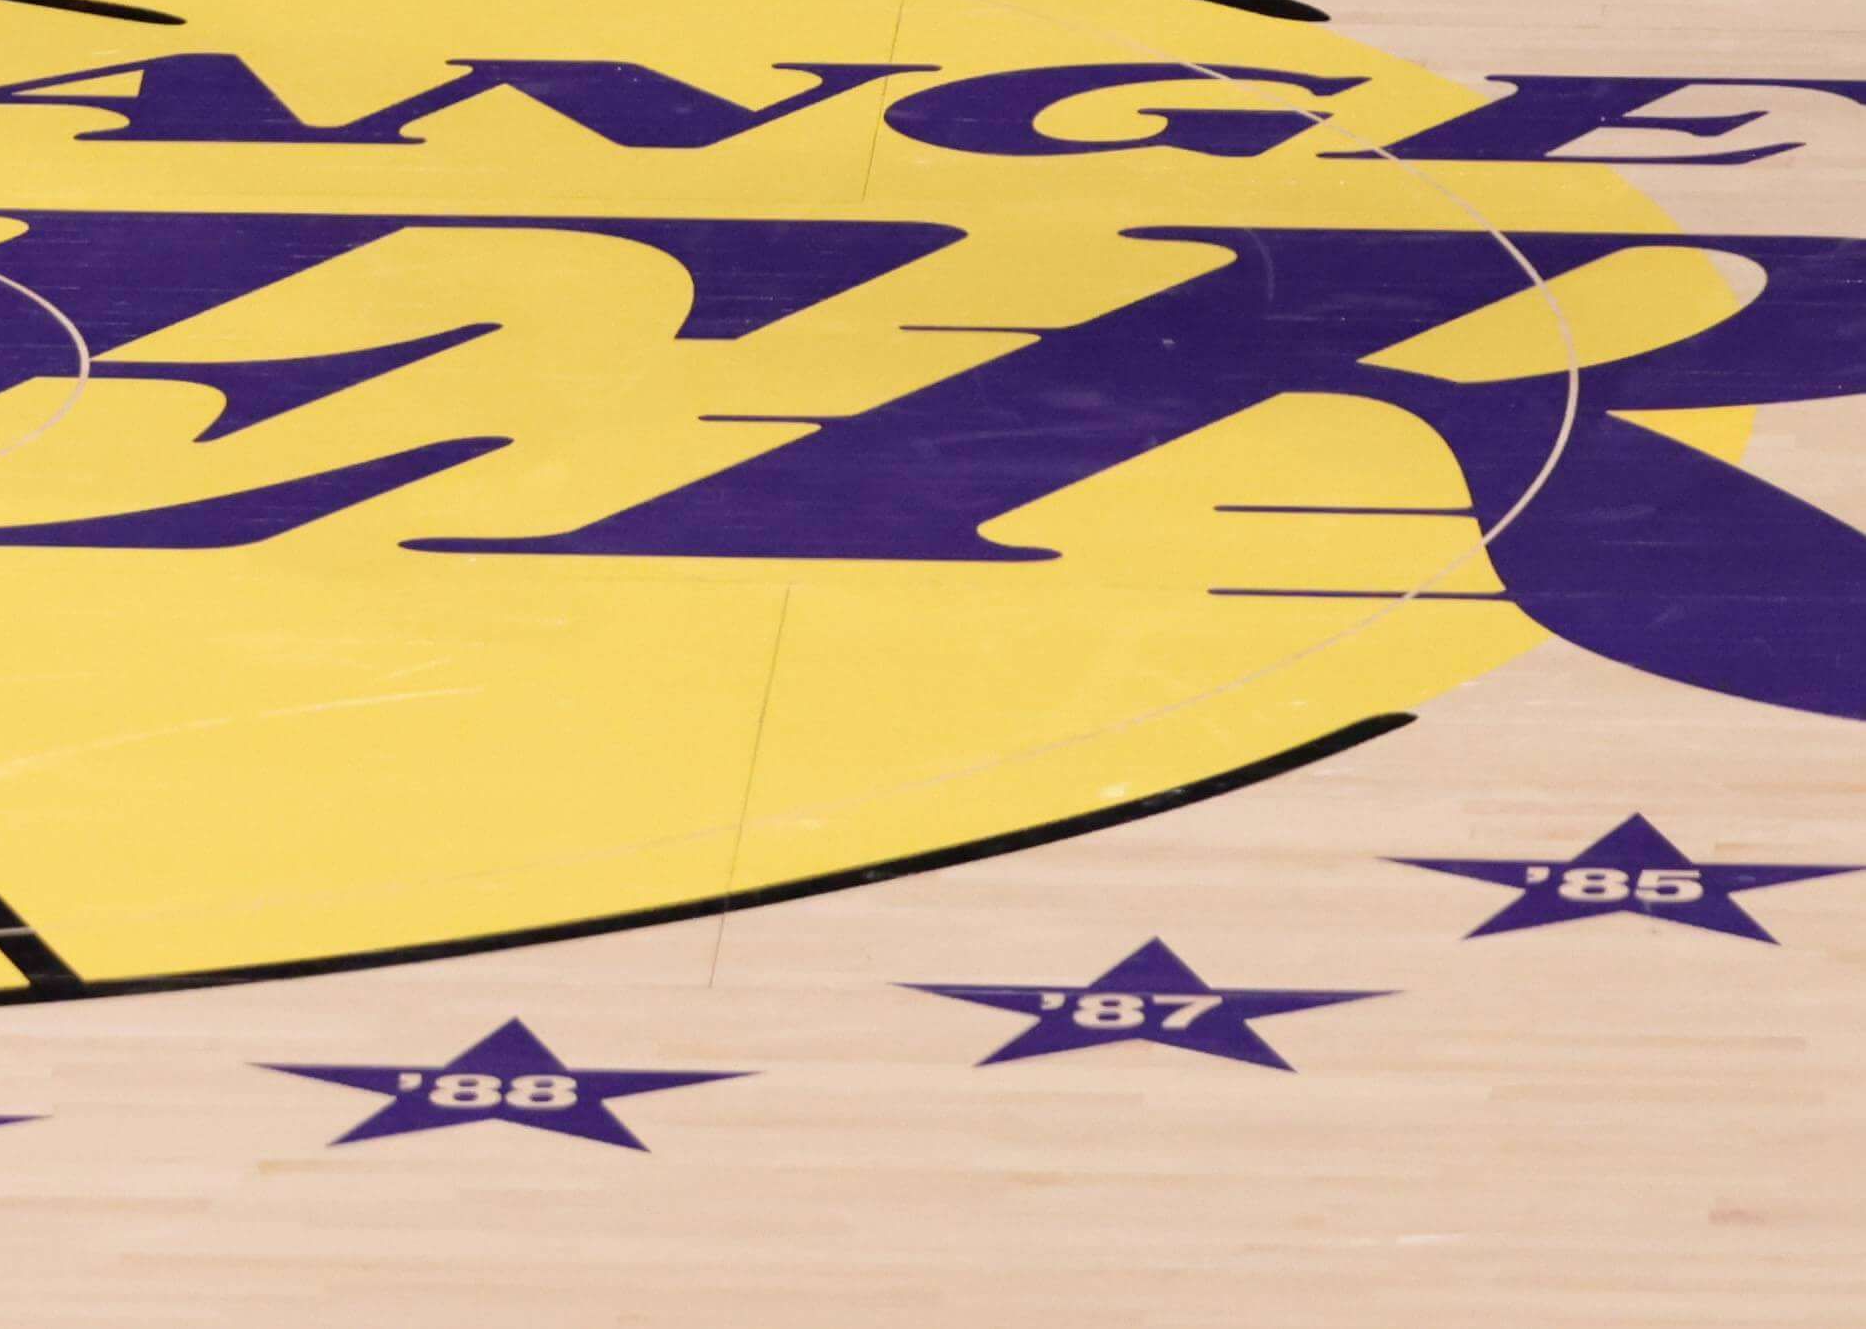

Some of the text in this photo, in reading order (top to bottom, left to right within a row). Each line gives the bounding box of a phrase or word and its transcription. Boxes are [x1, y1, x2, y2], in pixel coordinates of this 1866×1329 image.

[1525, 865, 1706, 904] '85
[1038, 990, 1224, 1032] '87
[398, 1071, 580, 1112] '88
